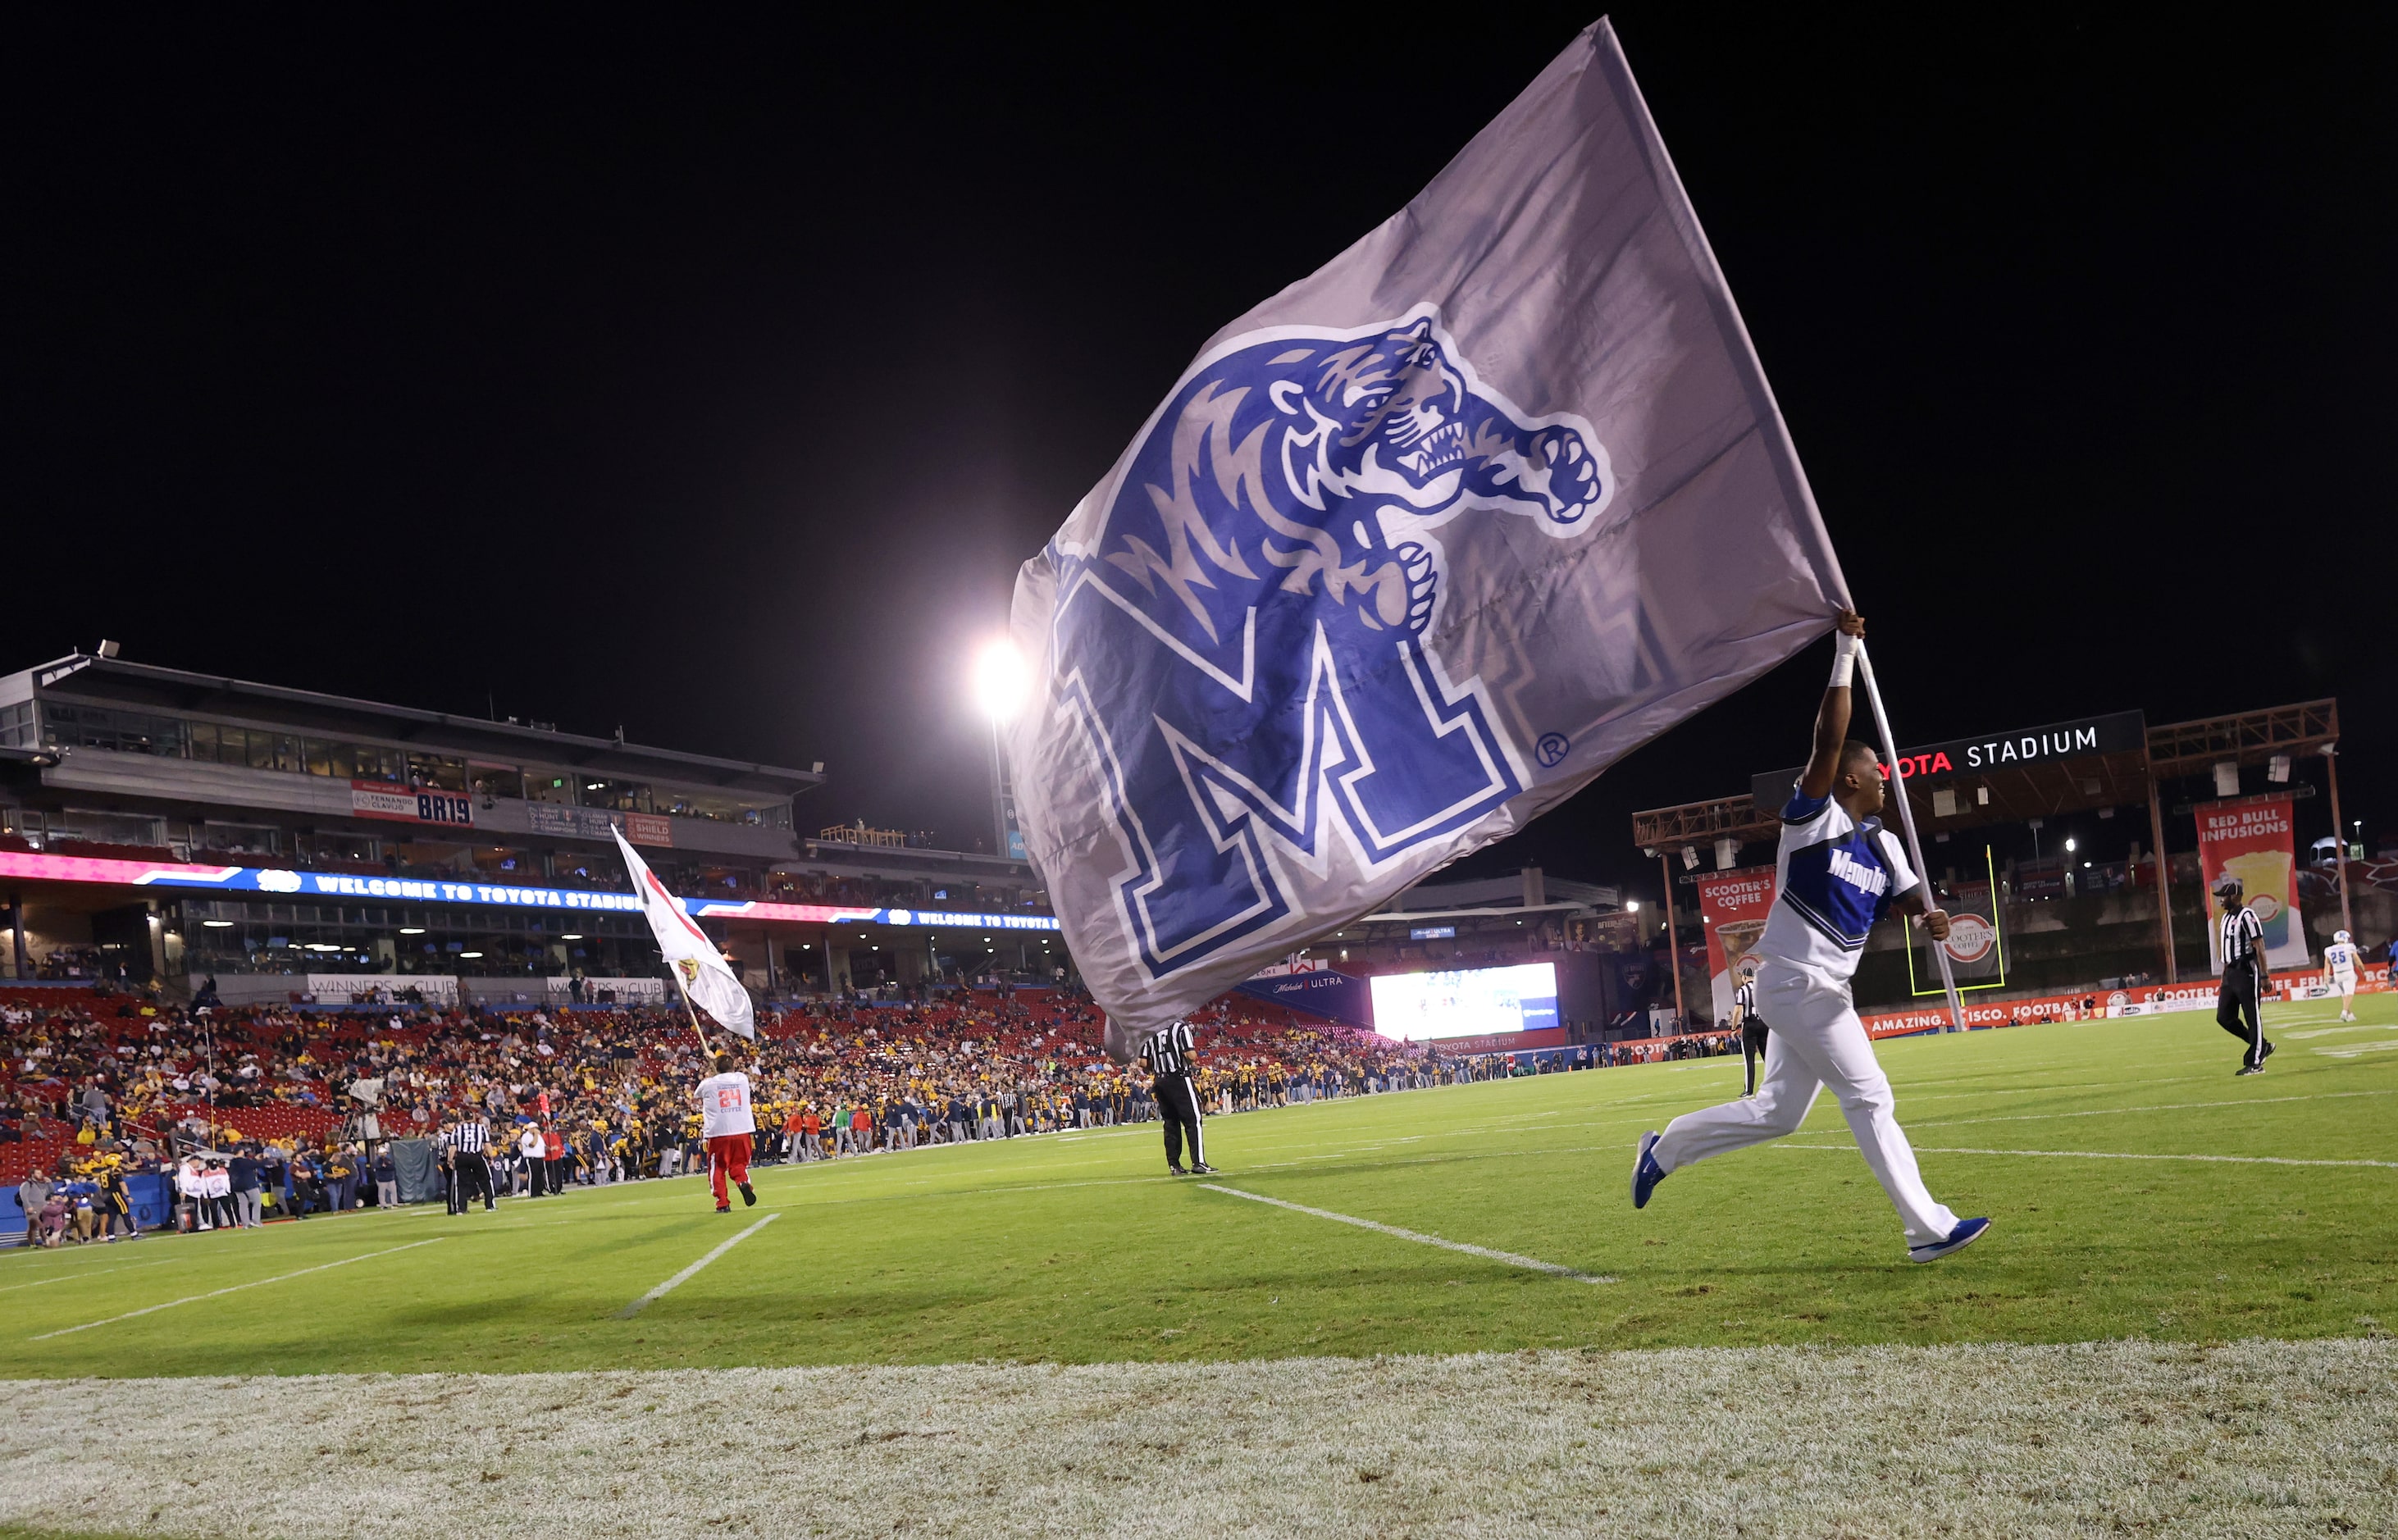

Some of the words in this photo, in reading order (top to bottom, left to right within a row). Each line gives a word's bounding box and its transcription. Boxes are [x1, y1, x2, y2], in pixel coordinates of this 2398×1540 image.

[1876, 752, 1953, 781] YOTA
[1967, 727, 2096, 768] STADIUM
[371, 795, 413, 805] FERNANDO
[372, 801, 404, 811] CLAVIJO
[417, 793, 471, 824] BR19
[2209, 815, 2237, 829] RED
[2242, 809, 2279, 824] BULL
[636, 824, 668, 836] SHIELD
[636, 833, 670, 842] WINNERS
[2202, 820, 2288, 842] INFUSIONS
[315, 876, 436, 898] WELCOME
[442, 884, 472, 900] TO
[476, 886, 561, 905] TOYOTA
[1705, 879, 1771, 898] SCOOTER'S
[1717, 892, 1762, 907] COFFEE
[917, 912, 982, 927] WELCOME
[983, 915, 1001, 927] TO
[1003, 916, 1050, 929] TOYOTA
[2331, 951, 2346, 964] 25
[414, 980, 458, 995] CLUB
[628, 982, 662, 995] CLUB
[1311, 977, 1343, 988] ULTRA
[1871, 1015, 1946, 1032] AMAZING.
[1953, 1009, 2008, 1024] ISCO.
[2013, 1000, 2086, 1019] FOOTBAL
[1436, 1041, 1471, 1052] TOYOTA
[1474, 1037, 1516, 1049] STADIUM
[718, 1089, 742, 1109] 24
[463, 1128, 476, 1142] H
[100, 1173, 110, 1189] 8
